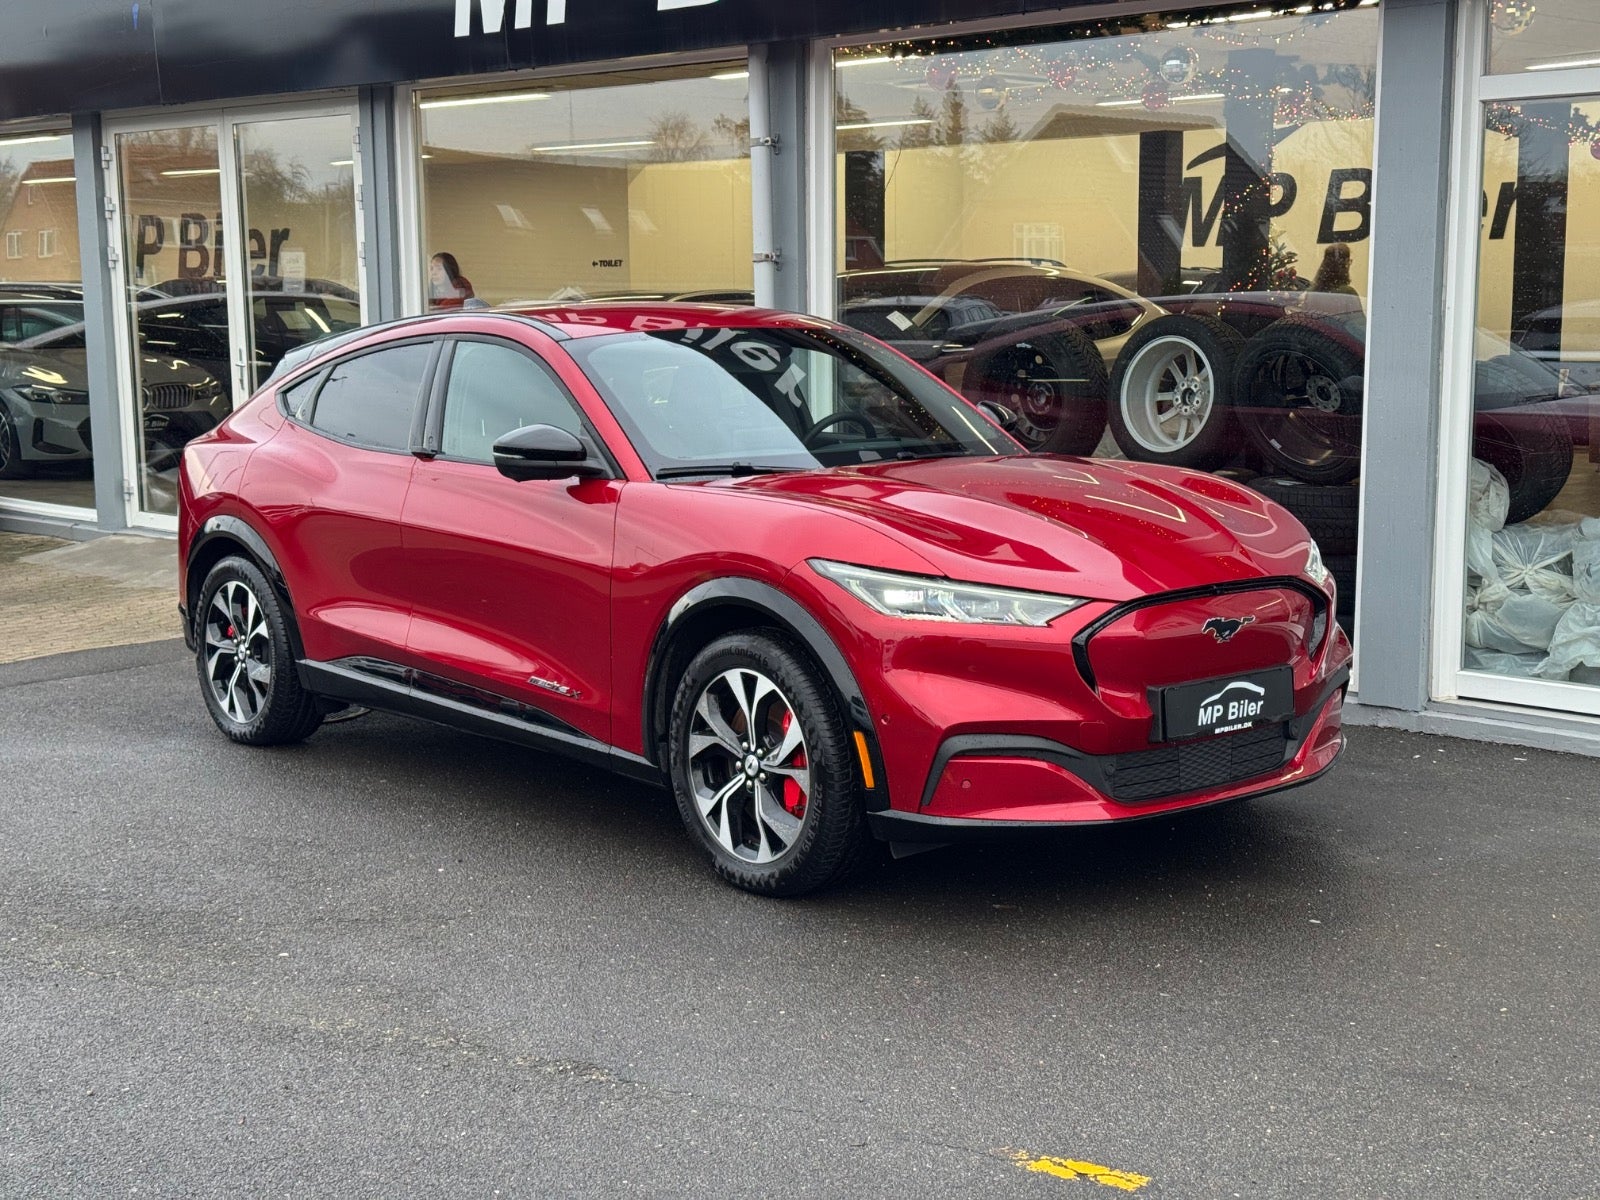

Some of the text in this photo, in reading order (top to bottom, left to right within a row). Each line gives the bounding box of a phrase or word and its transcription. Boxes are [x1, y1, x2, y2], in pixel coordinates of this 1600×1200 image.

[136, 214, 165, 278] P
[178, 212, 290, 279] Bier
[599, 259, 623, 268] TOILET
[1198, 699, 1264, 726] MP Biler
[1214, 721, 1253, 734] MPBILER.DK
